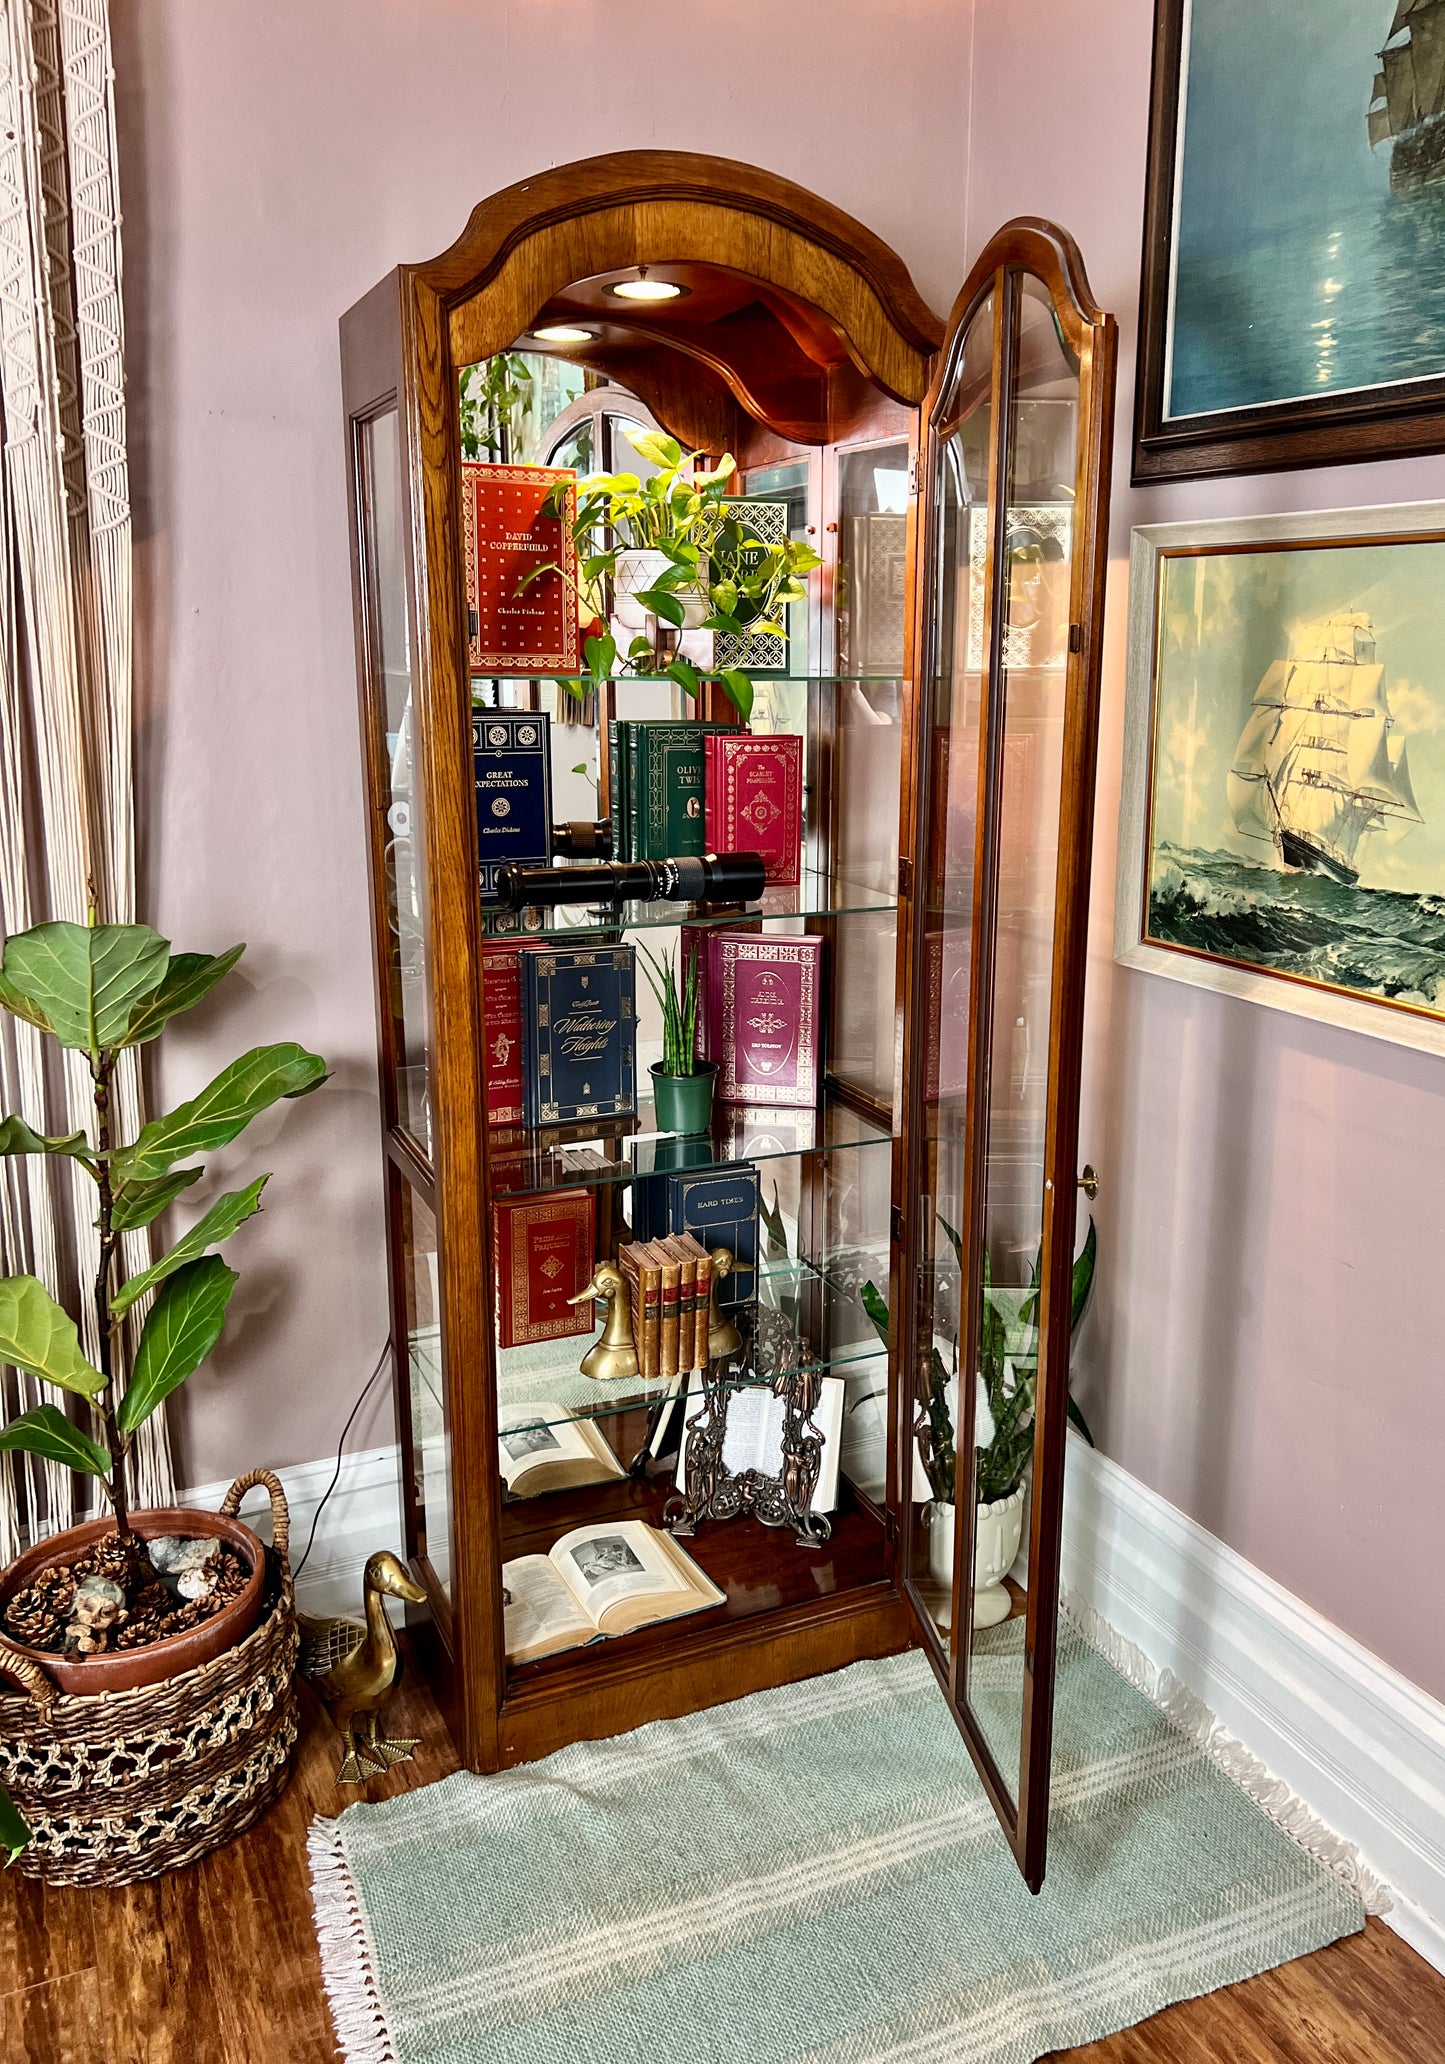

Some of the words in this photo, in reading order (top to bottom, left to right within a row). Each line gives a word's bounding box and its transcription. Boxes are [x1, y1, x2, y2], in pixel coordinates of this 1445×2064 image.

[505, 532, 533, 541] DAVID
[489, 541, 549, 552] COPPERFIELD
[486, 771, 514, 779] GREAT
[676, 766, 701, 775] OLIV
[475, 779, 529, 788] XPECTATIONS
[679, 776, 701, 785] TWIS
[553, 1015, 618, 1035] Wuthering
[560, 1036, 610, 1057] Heights
[697, 1200, 719, 1209] HARD
[720, 1196, 744, 1205] TIMES
